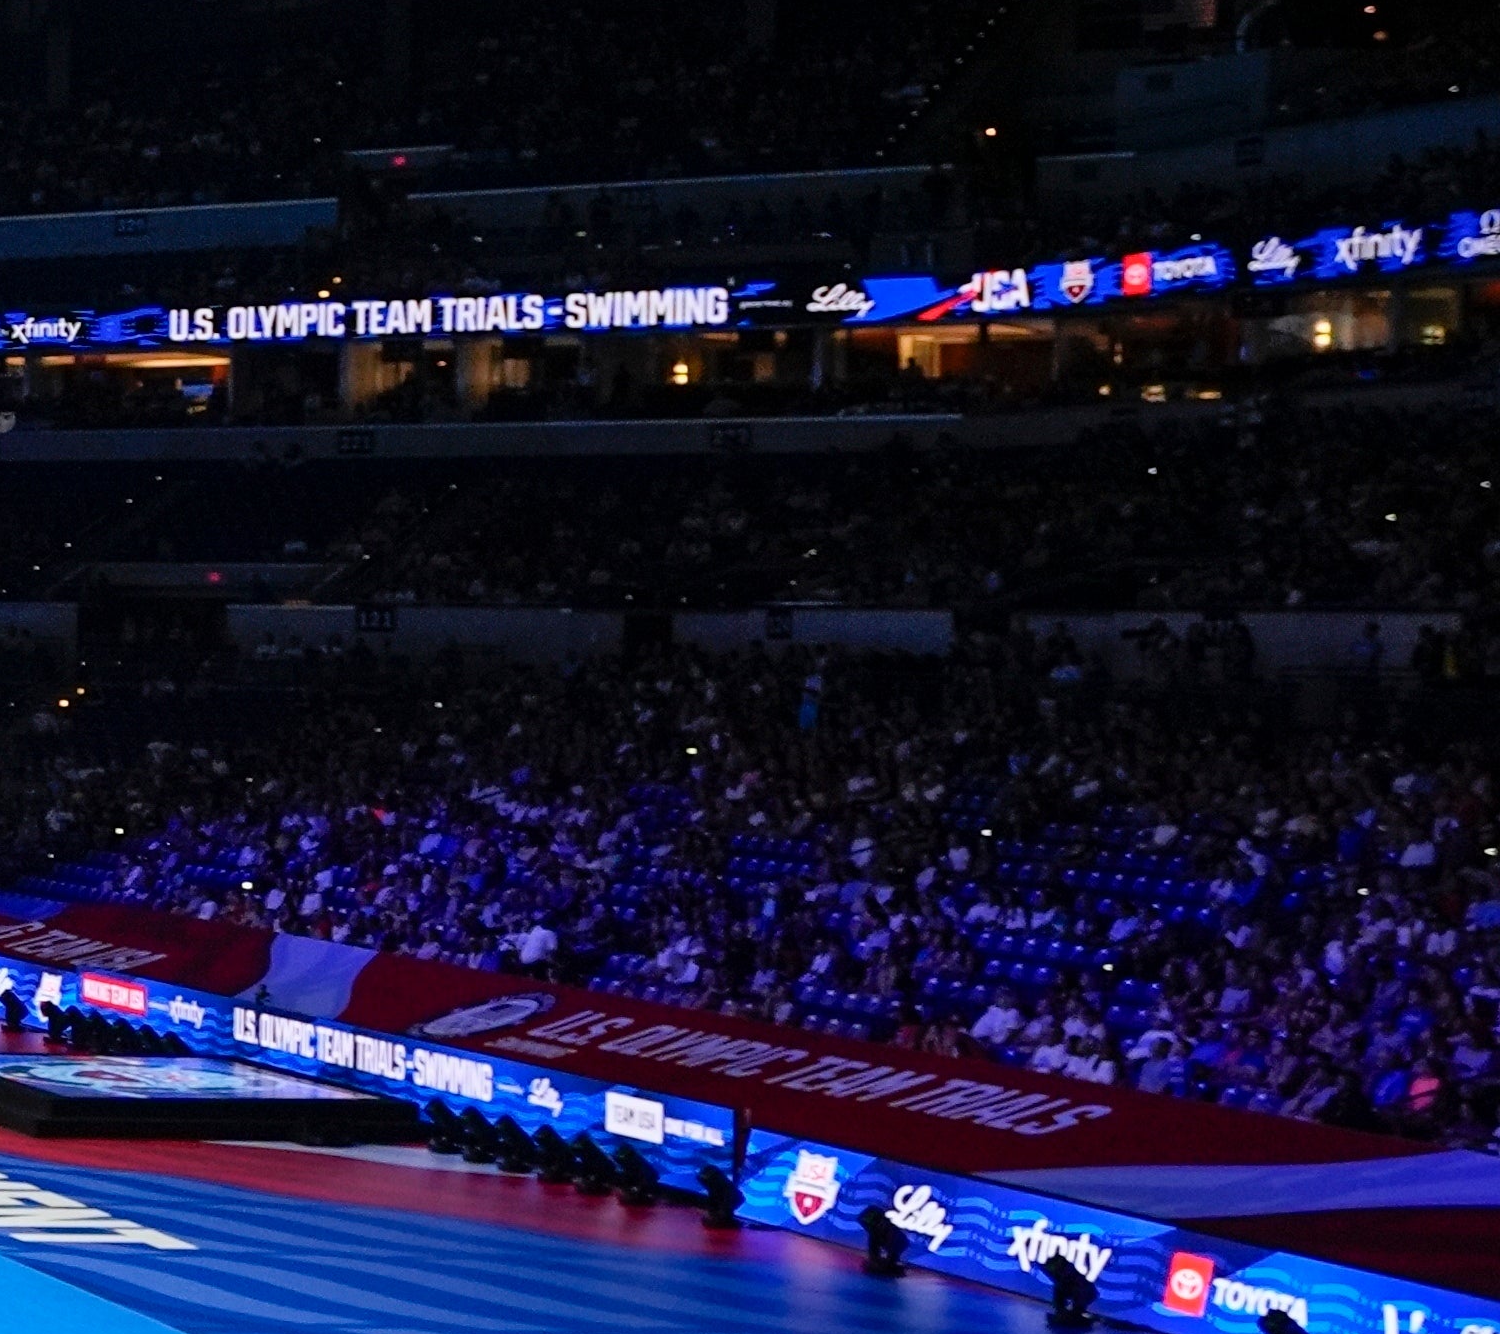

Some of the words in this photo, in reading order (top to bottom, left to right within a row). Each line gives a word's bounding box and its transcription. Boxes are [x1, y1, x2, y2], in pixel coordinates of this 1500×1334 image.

[1152, 256, 1217, 283] TOYOTA
[1334, 224, 1423, 271] xfinity
[167, 308, 218, 343] U.S.
[226, 301, 347, 341] OLYMPIC
[351, 298, 433, 337] TEAM
[438, 292, 545, 334] TRIALS
[233, 1005, 258, 1044] U.S.
[259, 1013, 316, 1059] OLYMPIC
[316, 1024, 355, 1070] TEAM
[355, 1033, 406, 1082] TRIALS
[412, 1047, 494, 1103] SWIMMING
[526, 1009, 636, 1045] U.S.
[599, 1023, 809, 1079] OLYMPIC
[764, 1054, 904, 1103] TEAM
[888, 1072, 1114, 1136] TRIALS
[886, 1183, 953, 1253] Lilly
[1213, 1276, 1308, 1328] TOYOTA
